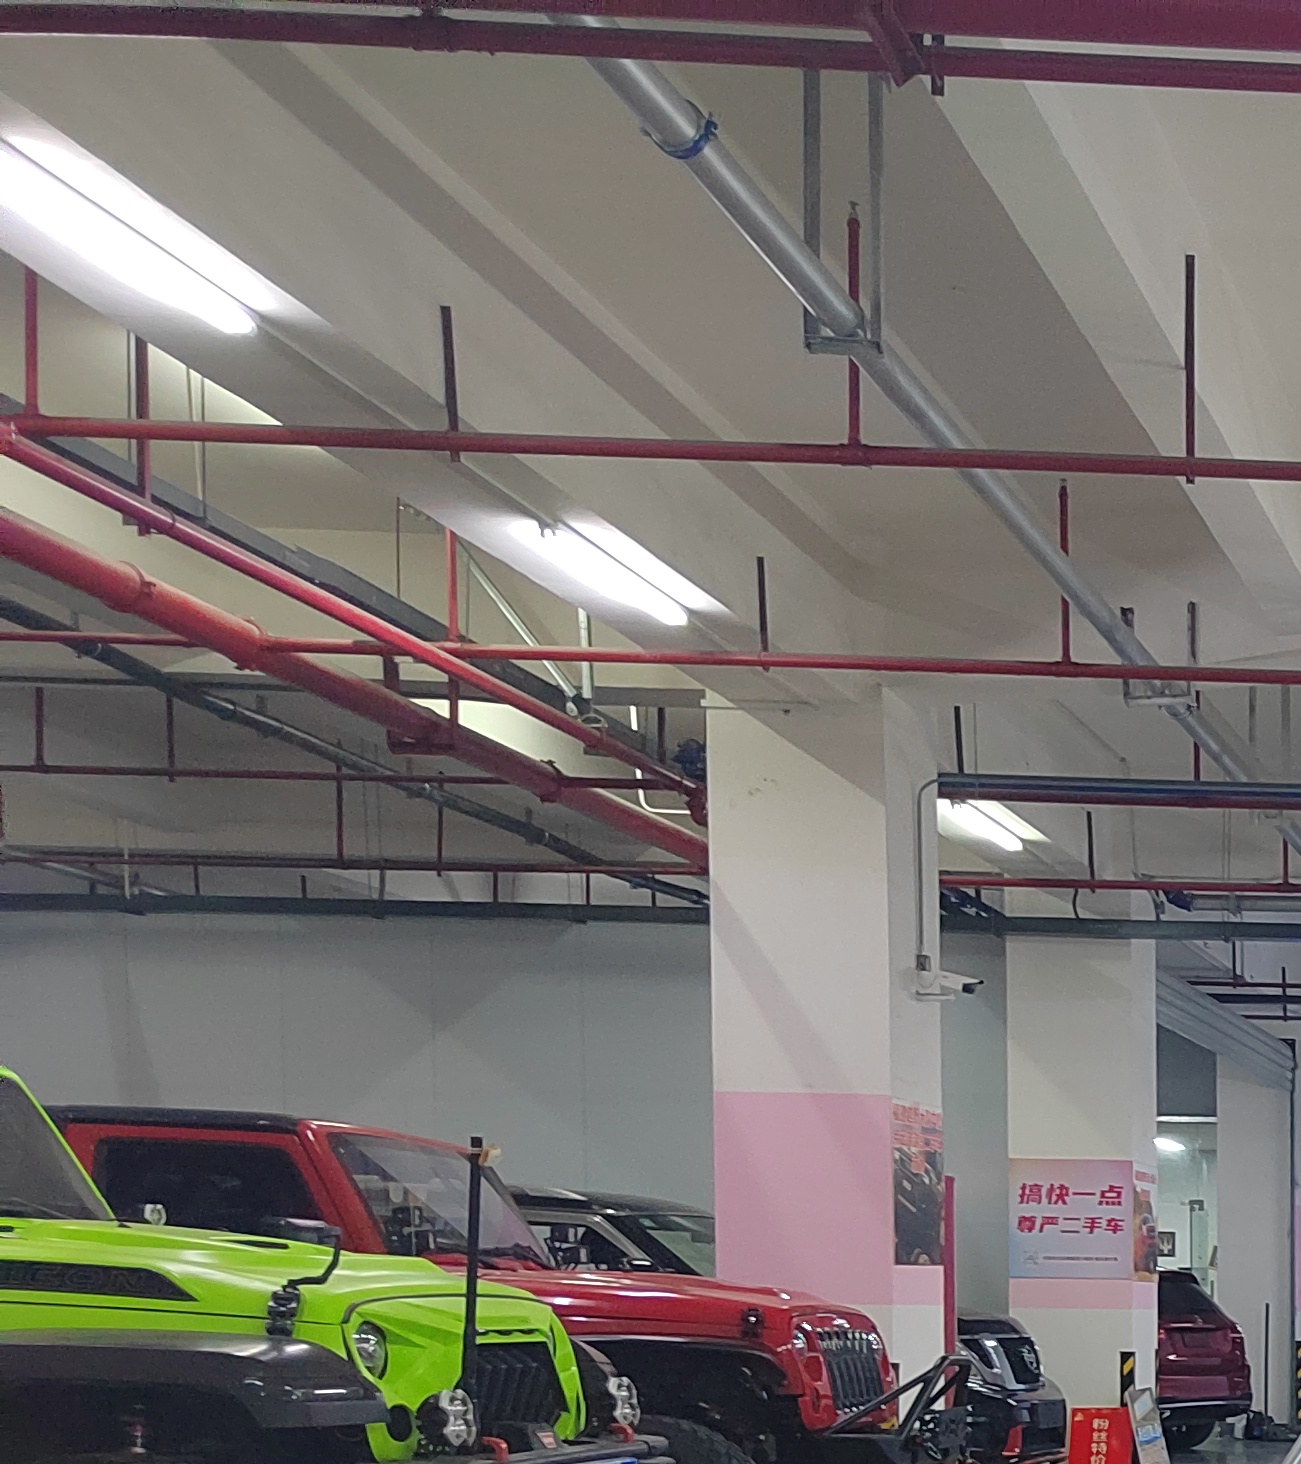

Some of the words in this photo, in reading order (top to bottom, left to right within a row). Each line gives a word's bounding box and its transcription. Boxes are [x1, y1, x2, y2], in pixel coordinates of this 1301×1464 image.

[1018, 1183, 1125, 1206] 搞快一点
[1017, 1215, 1125, 1234] 尊严二手车
